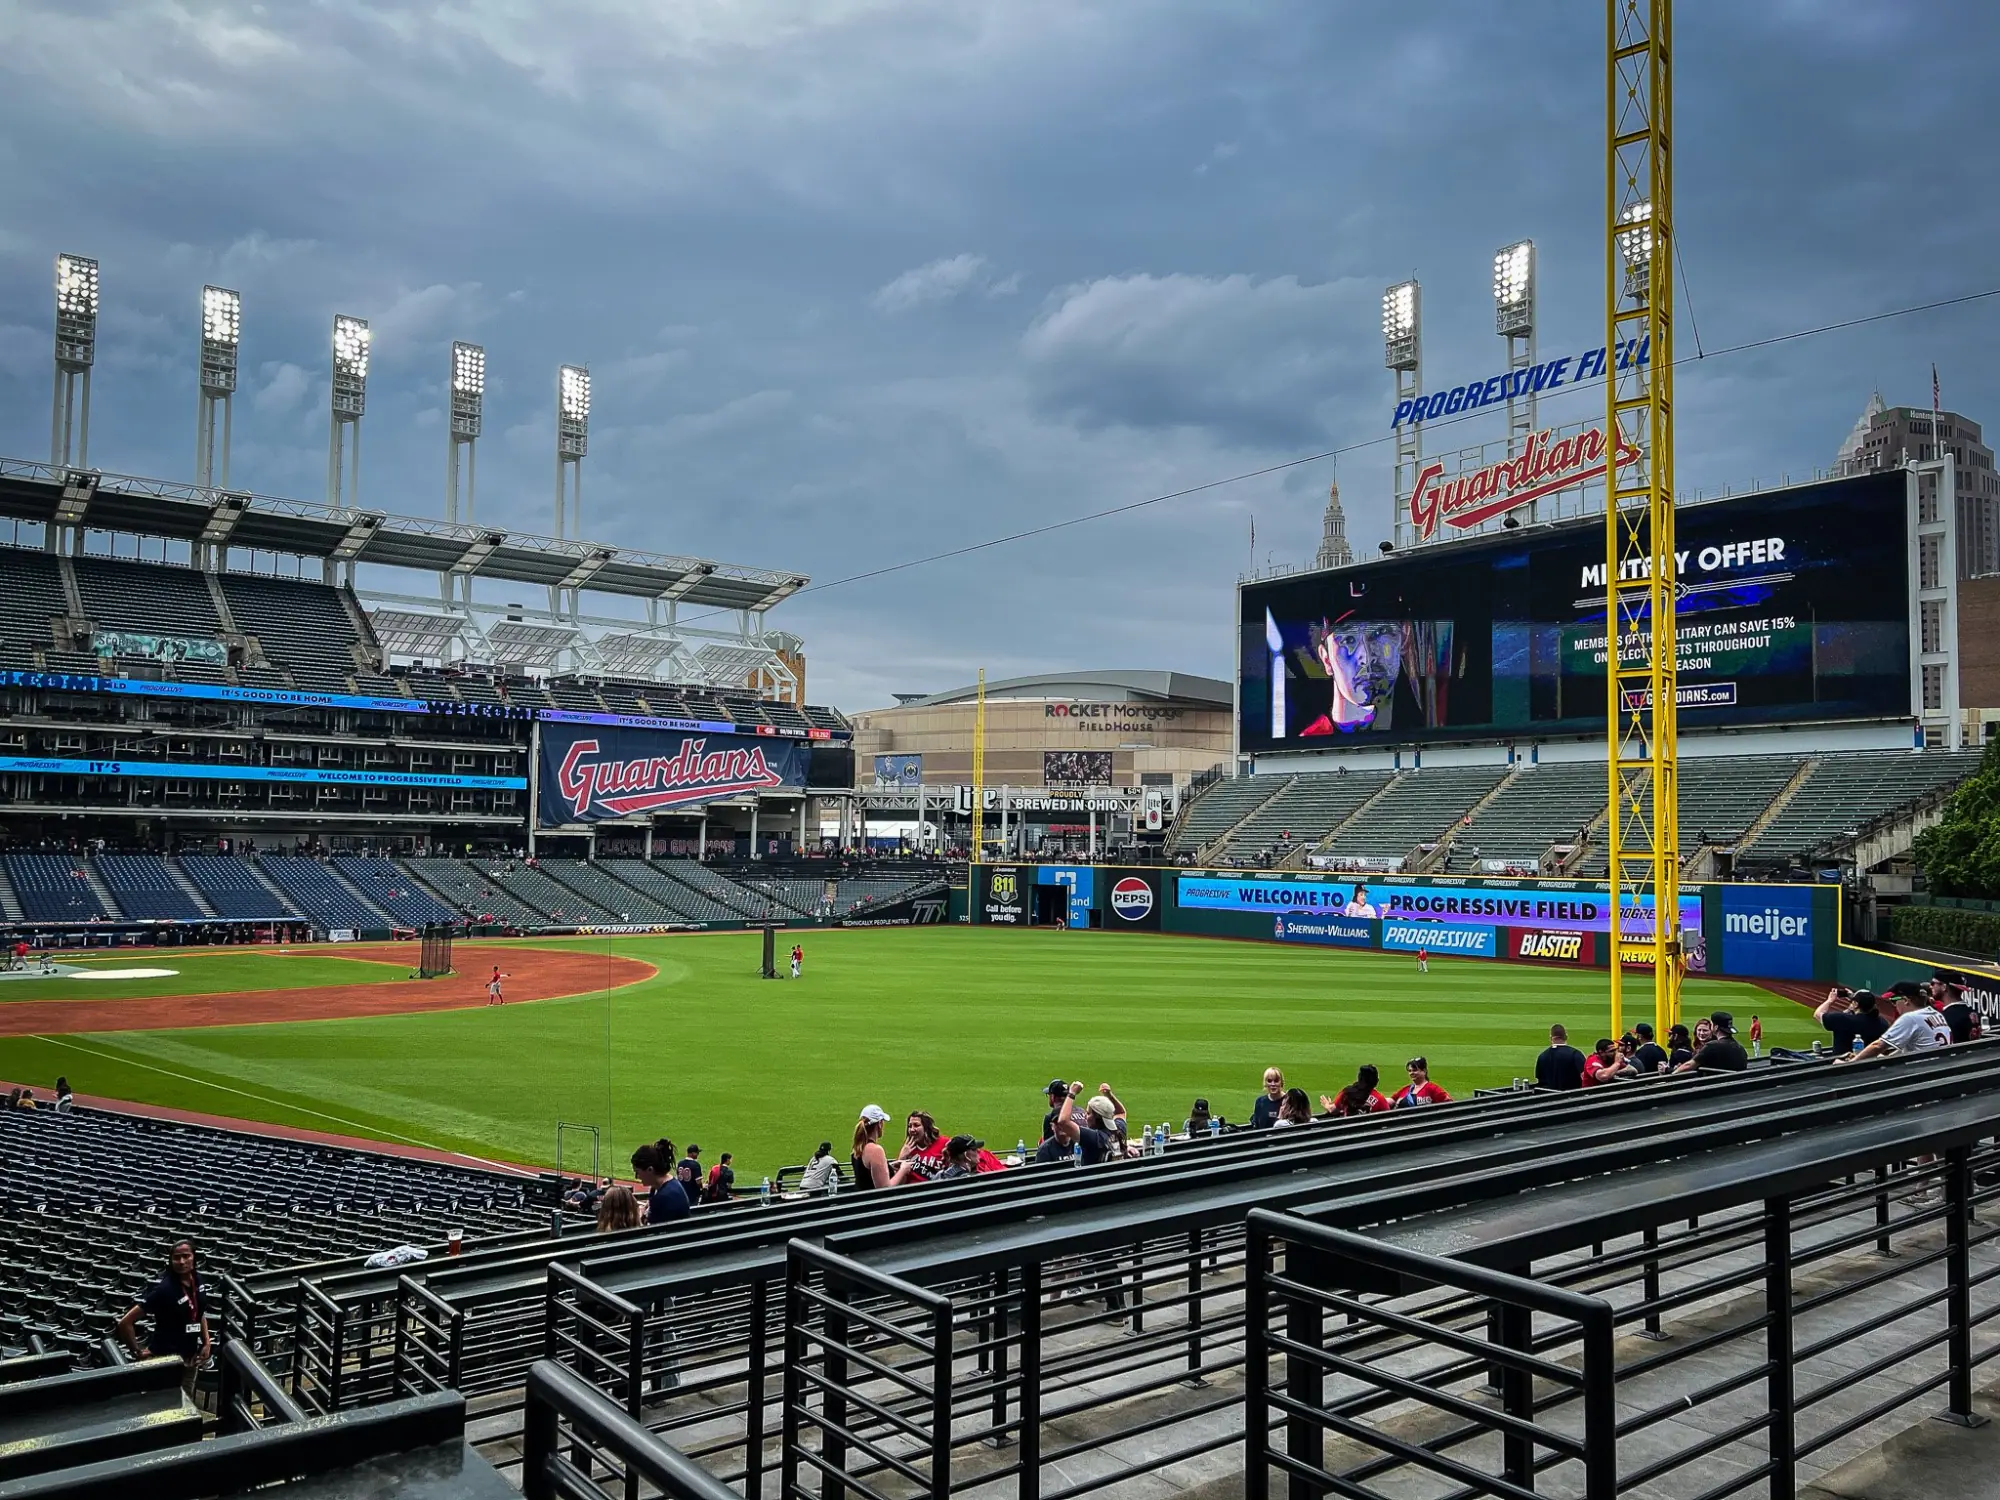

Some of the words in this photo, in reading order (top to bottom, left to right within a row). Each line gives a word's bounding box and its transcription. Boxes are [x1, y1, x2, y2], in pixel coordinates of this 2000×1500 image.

[1390, 355, 1573, 430] PROGRESSIVE
[1408, 415, 1643, 542] Guardians
[1697, 536, 1786, 572] OFFER
[1573, 634, 1623, 651] MEMBES
[1624, 633, 1638, 646] OF
[1713, 622, 1739, 636] CAN
[1739, 618, 1770, 634] SAVE
[1770, 615, 1796, 631] 15%
[1616, 647, 1647, 661] ELECT
[1693, 634, 1772, 654] THROUGHOUT
[1675, 656, 1712, 672] EASON
[220, 688, 240, 697] IT'S
[242, 690, 273, 700] GOOD
[275, 692, 288, 701] TO
[303, 694, 333, 704] HOME
[1045, 703, 1112, 718] ROCKET
[1113, 704, 1185, 721] Mortgage
[619, 717, 634, 725] IT'S
[634, 718, 657, 726] GOOD
[669, 720, 679, 728] BE
[679, 721, 701, 729] HOME
[89, 762, 121, 774] IT'S
[317, 772, 363, 782] WELCOME
[364, 774, 376, 782] TO
[377, 775, 438, 784] PROGRESSIVE
[438, 777, 462, 785] FIELD
[558, 738, 783, 818] Guardians
[1048, 790, 1084, 798] PROUDLY
[1015, 798, 1069, 811] BREWED
[1070, 799, 1085, 811] IN
[1087, 799, 1119, 812] OHIO
[1147, 798, 1161, 811] Lite
[993, 876, 1014, 893] 811
[1337, 875, 1370, 883] PROGRESSIVE
[1383, 876, 1417, 884] PROGRESSIVE
[1431, 877, 1467, 886] PROGRESSIVE
[1482, 879, 1522, 887] PROGRESSIVE
[1537, 881, 1577, 889] PROGRESSIVE
[1113, 893, 1150, 904] PEPSI
[1185, 888, 1232, 899] PROGRESSIVE
[1238, 887, 1318, 906] WELCOME
[1321, 891, 1345, 908] TO
[1389, 893, 1532, 918] PROGRESSIVE
[1536, 900, 1599, 921] FIELD
[985, 904, 998, 913] Call
[1000, 904, 1022, 914] before
[991, 914, 1003, 923] you
[1003, 913, 1017, 923] dig.
[1725, 908, 1808, 941] meijer
[594, 925, 651, 934] CONRAD'S
[1384, 926, 1488, 949] PROGRESSIVE
[1519, 933, 1583, 960] BLASTER
